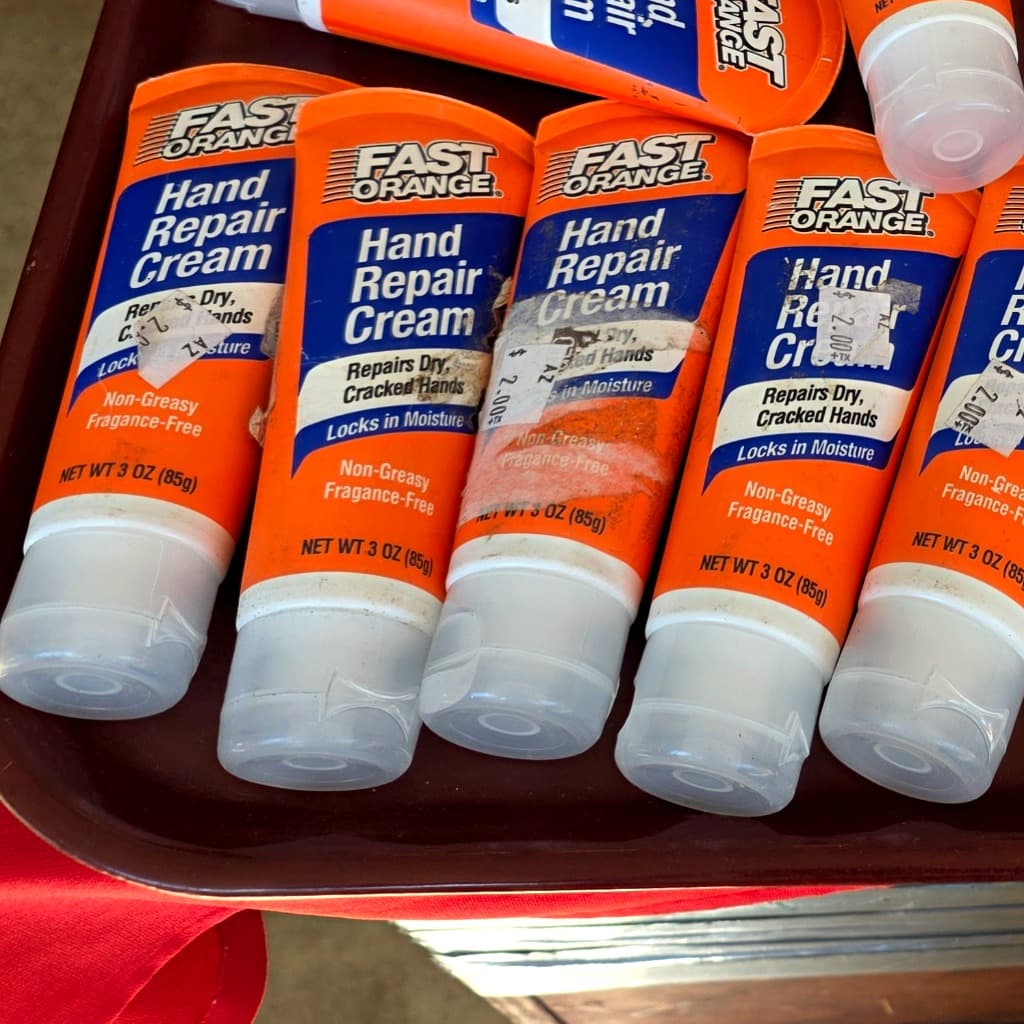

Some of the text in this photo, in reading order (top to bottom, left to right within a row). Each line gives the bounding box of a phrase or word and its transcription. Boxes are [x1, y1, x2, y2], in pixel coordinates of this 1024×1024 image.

[356, 140, 498, 177] FAST
[569, 134, 717, 178] FAST
[155, 169, 271, 214] Hand
[350, 175, 494, 202] ORANGE
[560, 163, 703, 196] ORANGE
[795, 177, 933, 212] FAST
[141, 201, 286, 252] Repair
[559, 207, 665, 252] Hand
[788, 208, 927, 235] ORANGE
[359, 224, 463, 263] Hand
[129, 242, 273, 289] Cream
[351, 261, 482, 305] Repair
[547, 242, 683, 290] Repair
[788, 258, 891, 291] Hand
[538, 278, 669, 327] Cream
[344, 307, 474, 345] Cream
[830, 315, 855, 352] 2.00
[347, 354, 450, 381] Repairs Dry,
[103, 391, 199, 415] Non-Greasy
[343, 376, 464, 404] Cracked Hands
[957, 386, 999, 426] 2.00
[86, 413, 202, 437] Fragance-Free
[327, 408, 464, 441] Locks in Moisture
[60, 463, 198, 494] NET WT 3 OZ (85g)
